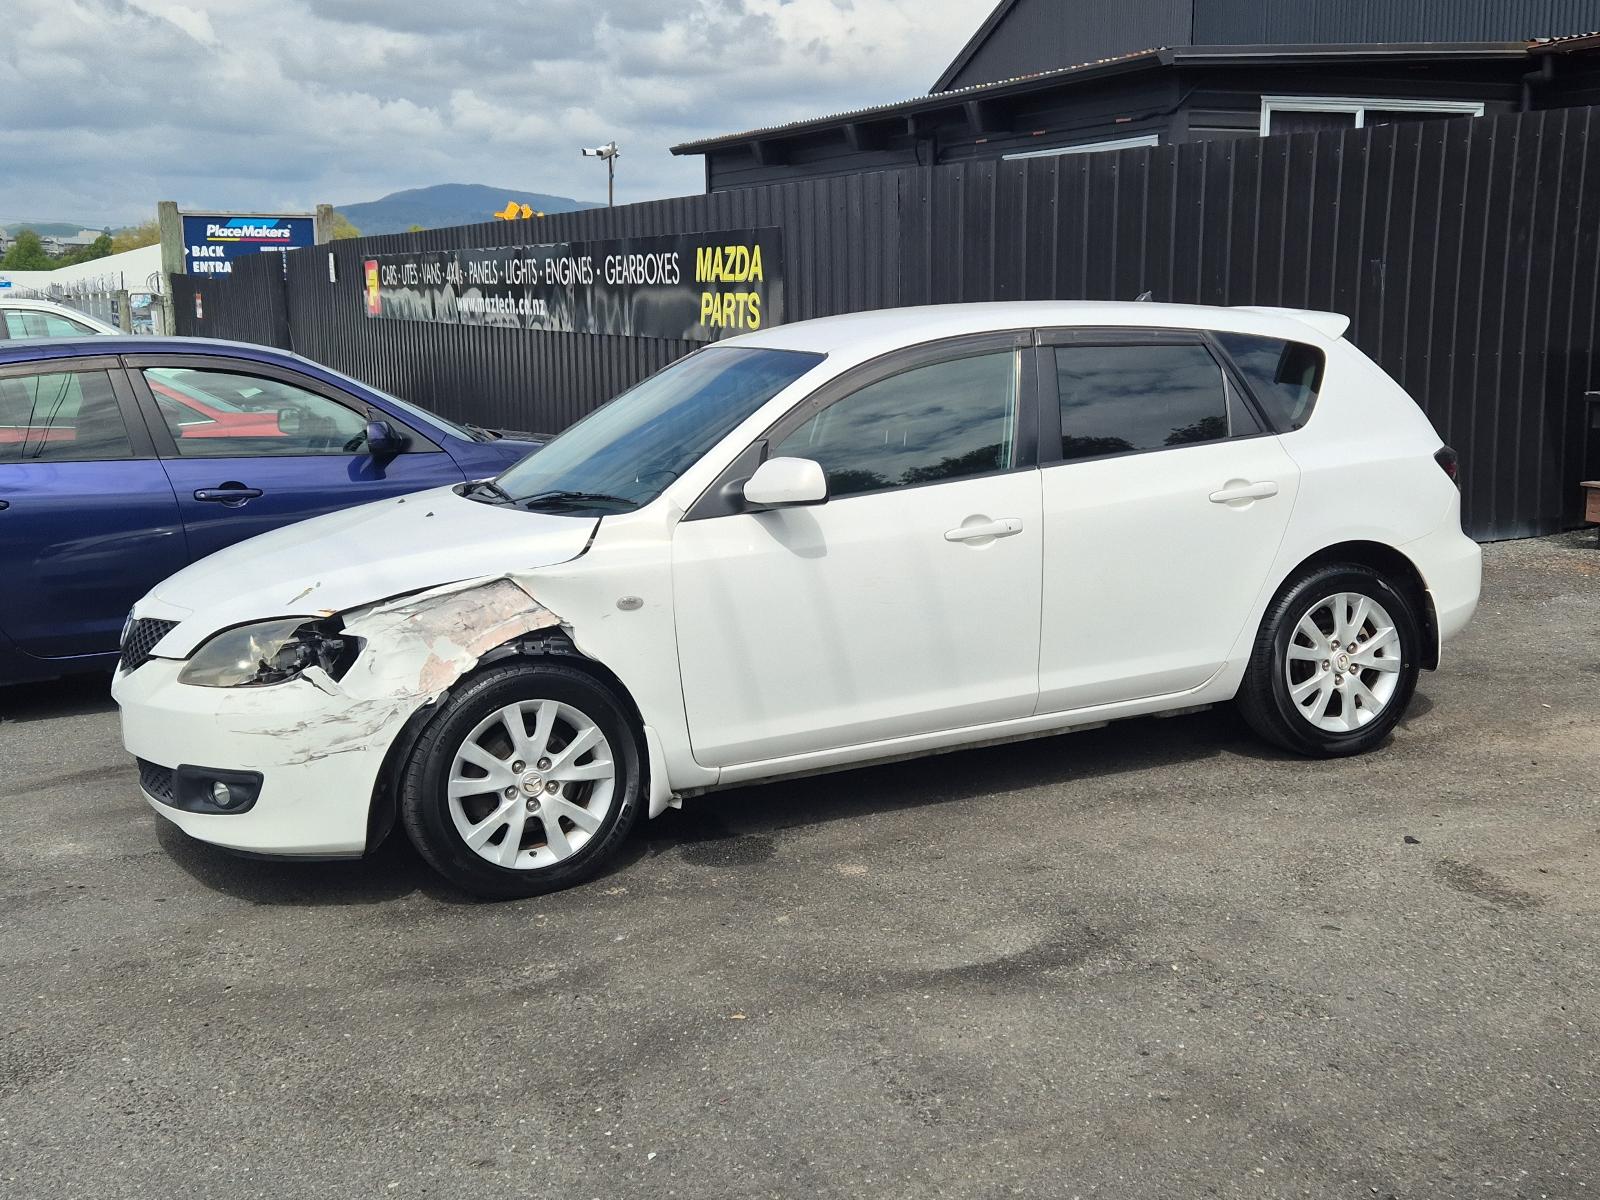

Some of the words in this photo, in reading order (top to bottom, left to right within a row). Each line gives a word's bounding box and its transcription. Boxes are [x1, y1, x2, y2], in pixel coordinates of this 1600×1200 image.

[206, 224, 290, 238] PlaceMakers
[191, 245, 225, 257] BACK
[193, 261, 233, 273] ENTRA
[381, 264, 398, 286] CARS
[401, 263, 419, 285] UTES
[421, 262, 442, 285] VANS
[468, 260, 498, 285] PANELS
[505, 258, 538, 285] LIGHTS
[545, 256, 593, 285] ENGINES
[605, 252, 680, 285] GEARBOXES
[696, 244, 763, 283] MAZDA
[701, 291, 760, 330] PARTS
